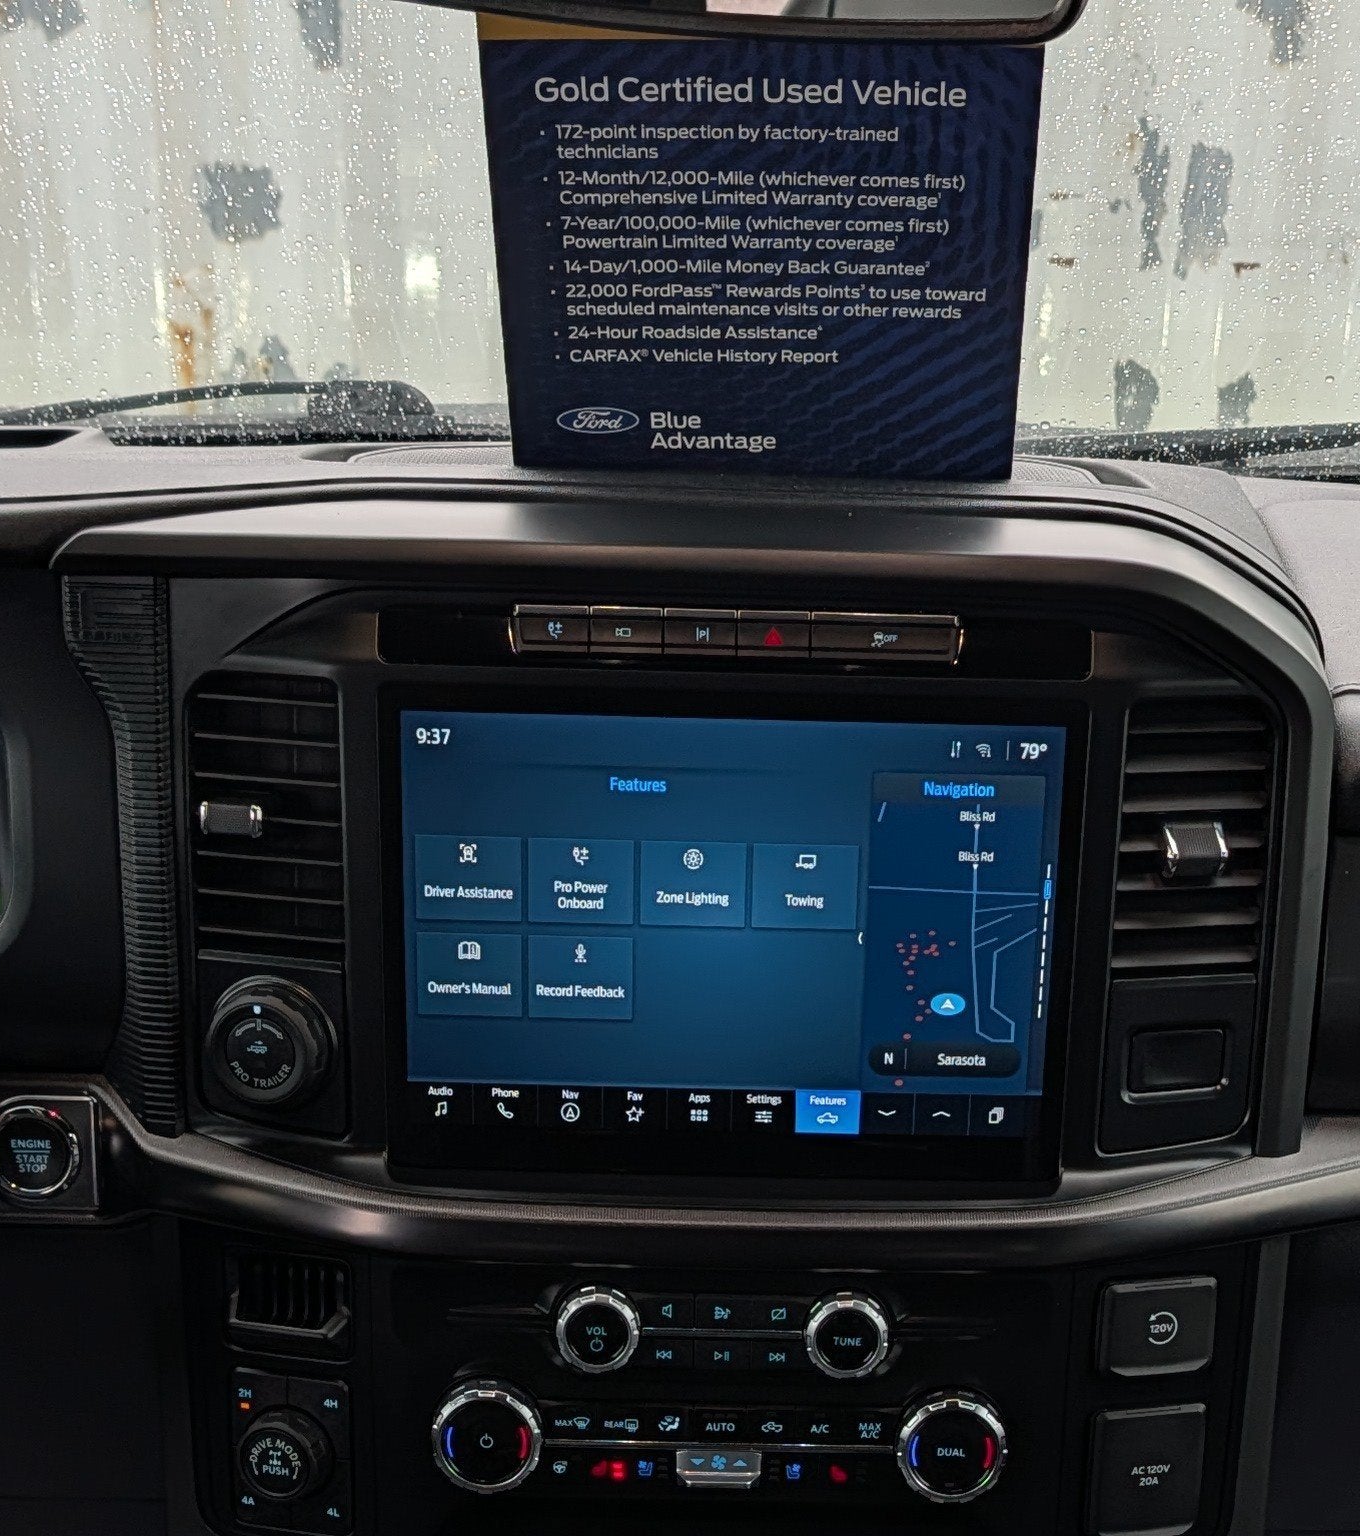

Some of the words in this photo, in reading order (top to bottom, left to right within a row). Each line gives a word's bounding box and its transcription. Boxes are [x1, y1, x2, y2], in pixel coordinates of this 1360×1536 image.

[535, 76, 609, 102] Gold
[618, 76, 753, 103] Certified
[762, 78, 843, 105] Used
[852, 80, 967, 107] Vehicle
[555, 124, 637, 141] 172-point
[641, 124, 734, 142] inspection
[738, 124, 760, 142] by
[764, 124, 899, 143] factory-trained
[556, 144, 659, 159] technicians
[558, 170, 755, 187] 12-Month/12,000-Mile
[759, 170, 856, 188] (whichever
[860, 175, 920, 188] comes
[924, 173, 966, 192] first)
[559, 190, 698, 207] Comprehensive
[702, 190, 768, 206] Limited
[771, 191, 854, 210] Warranty
[560, 215, 741, 231] 7-Year/100,000-Mile
[745, 216, 842, 232] (whichever
[845, 219, 905, 232] comes
[907, 218, 950, 236] first)
[563, 235, 658, 250] Powertrain
[662, 235, 727, 250] Limited
[731, 235, 813, 252] Warranty
[564, 259, 722, 276] 14-Day/1,000-Mile
[726, 260, 784, 276] Money
[788, 260, 830, 275] Back
[565, 284, 628, 299] 22,000
[726, 283, 802, 298] Rewards
[868, 285, 887, 299] to
[890, 287, 921, 300] use
[925, 286, 987, 302] toward
[567, 302, 655, 316] scheduled
[659, 302, 771, 316] maintenance
[774, 302, 819, 317] visits
[822, 305, 840, 317] or
[843, 303, 889, 318] other
[892, 305, 962, 320] rewards
[568, 325, 638, 339] 24-Hour
[642, 325, 721, 340] Roadside
[653, 348, 714, 363] Vehicle
[717, 348, 777, 366] History
[781, 349, 840, 365] Report
[572, 410, 624, 430] Ford
[650, 411, 702, 430] Blue
[650, 431, 777, 453] Advantage
[883, 633, 899, 644] OFF
[416, 727, 451, 746] 9:37
[609, 775, 667, 795] Features
[924, 780, 995, 799] Navigation
[960, 811, 980, 823] Bliss
[982, 811, 996, 823] Rd
[958, 851, 979, 863] Bliss
[981, 851, 994, 863] Rd
[424, 884, 459, 900] Driver
[461, 884, 514, 901] Assistance
[554, 880, 572, 895] Pro
[574, 881, 608, 895] Power
[557, 896, 604, 911] Onboard
[656, 891, 683, 906] Zone
[685, 891, 730, 909] Lighting
[785, 894, 824, 910] Towing
[428, 981, 467, 997] Owner's
[468, 981, 512, 996] Manual
[536, 983, 570, 998] Record
[572, 983, 625, 999] Feedback
[884, 1052, 894, 1065] N
[937, 1053, 987, 1067] Sarasota
[229, 1060, 252, 1084] PRO
[252, 1062, 292, 1090] TRAILER
[428, 1086, 454, 1097] Audio
[491, 1087, 520, 1099] Phone
[562, 1089, 580, 1100] Nav
[627, 1091, 644, 1101] Fav
[688, 1093, 711, 1104] Apps
[746, 1094, 782, 1106] Settings
[810, 1095, 847, 1106] Features
[10, 1138, 52, 1150] ENGINE
[15, 1153, 49, 1165] START
[18, 1163, 48, 1174] STOP
[585, 1326, 607, 1337] VOL
[1149, 1322, 1175, 1335] 120V
[833, 1336, 863, 1347] TUNE
[237, 1387, 252, 1399] 2H
[323, 1398, 338, 1409] 4H
[554, 1418, 574, 1428] MAX
[604, 1419, 624, 1429] REAR
[705, 1422, 736, 1433] AUTO
[810, 1423, 830, 1434] A/C
[858, 1422, 882, 1433] MAX
[860, 1430, 880, 1440] A/C
[248, 1437, 273, 1464] DRIVE
[274, 1438, 302, 1469] MODE
[936, 1447, 966, 1458] DUAL
[262, 1464, 290, 1478] PUSH
[1130, 1465, 1146, 1476] AC
[1146, 1463, 1171, 1476] 120V
[1138, 1476, 1159, 1487] 20A
[240, 1495, 255, 1506] 4A
[326, 1507, 340, 1518] 4L
